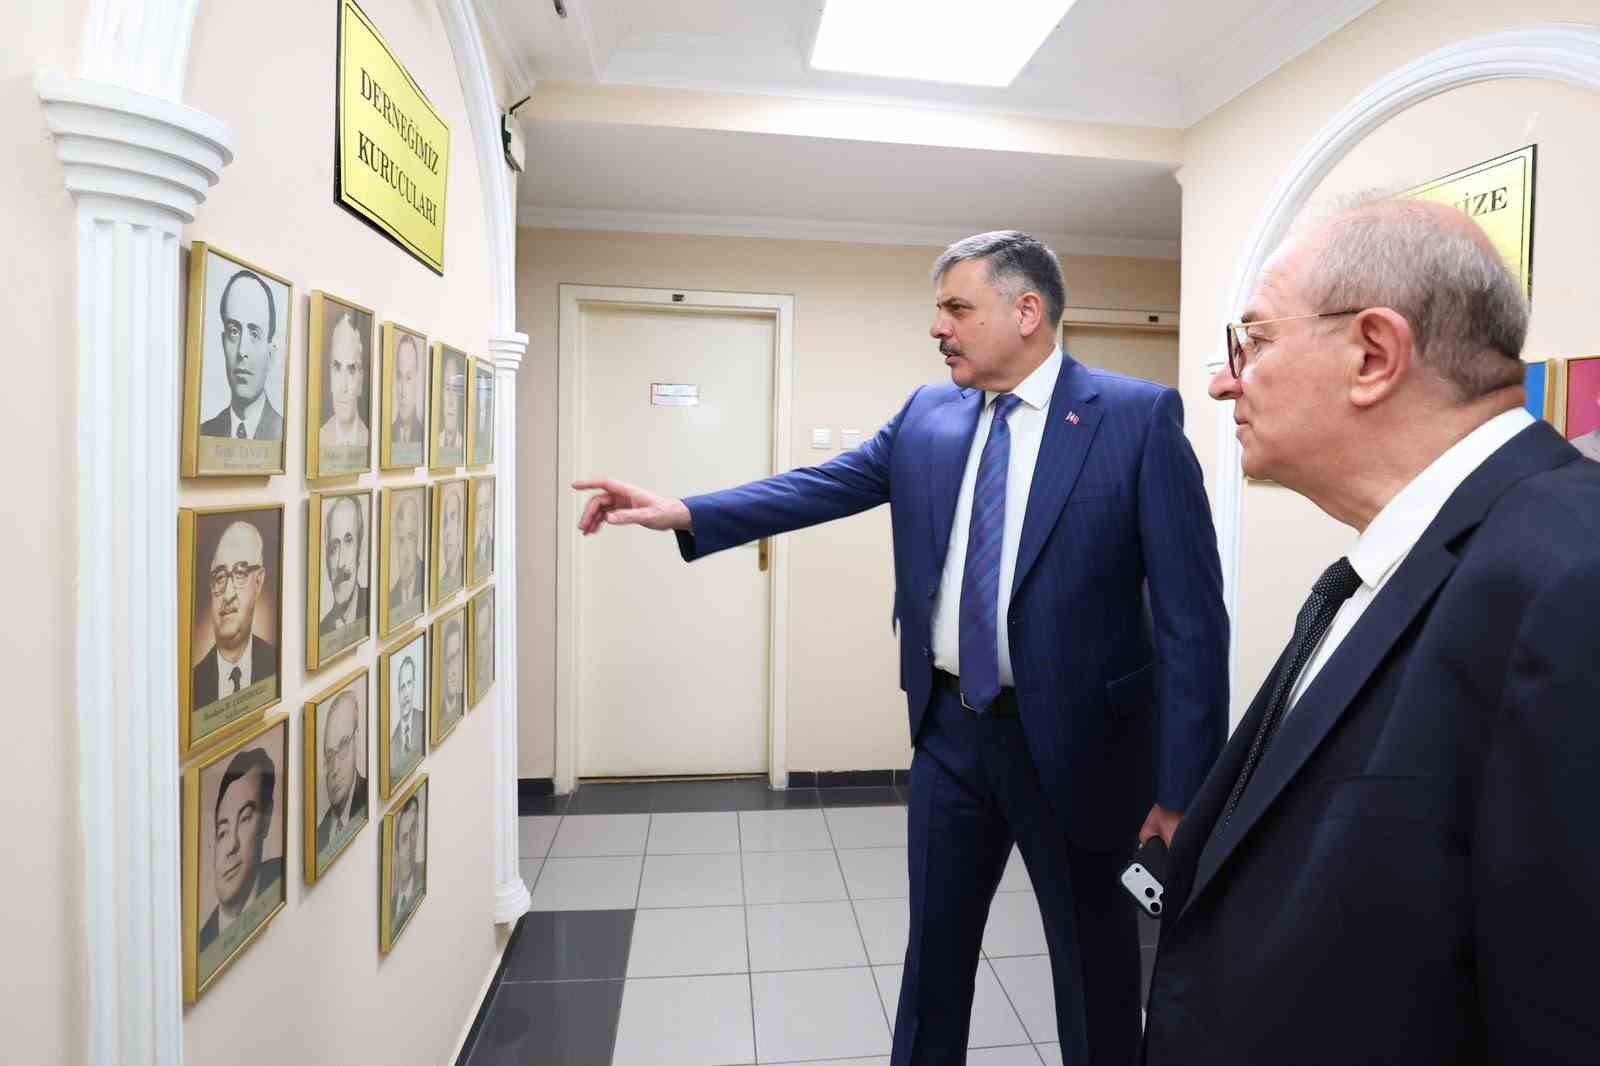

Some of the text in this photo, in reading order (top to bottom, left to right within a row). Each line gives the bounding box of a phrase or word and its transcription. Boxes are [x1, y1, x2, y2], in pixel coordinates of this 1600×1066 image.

[360, 67, 439, 175] DERNEĞİMİZ
[358, 130, 437, 226] KURUCULARI
[1454, 186, 1508, 217] İZE
